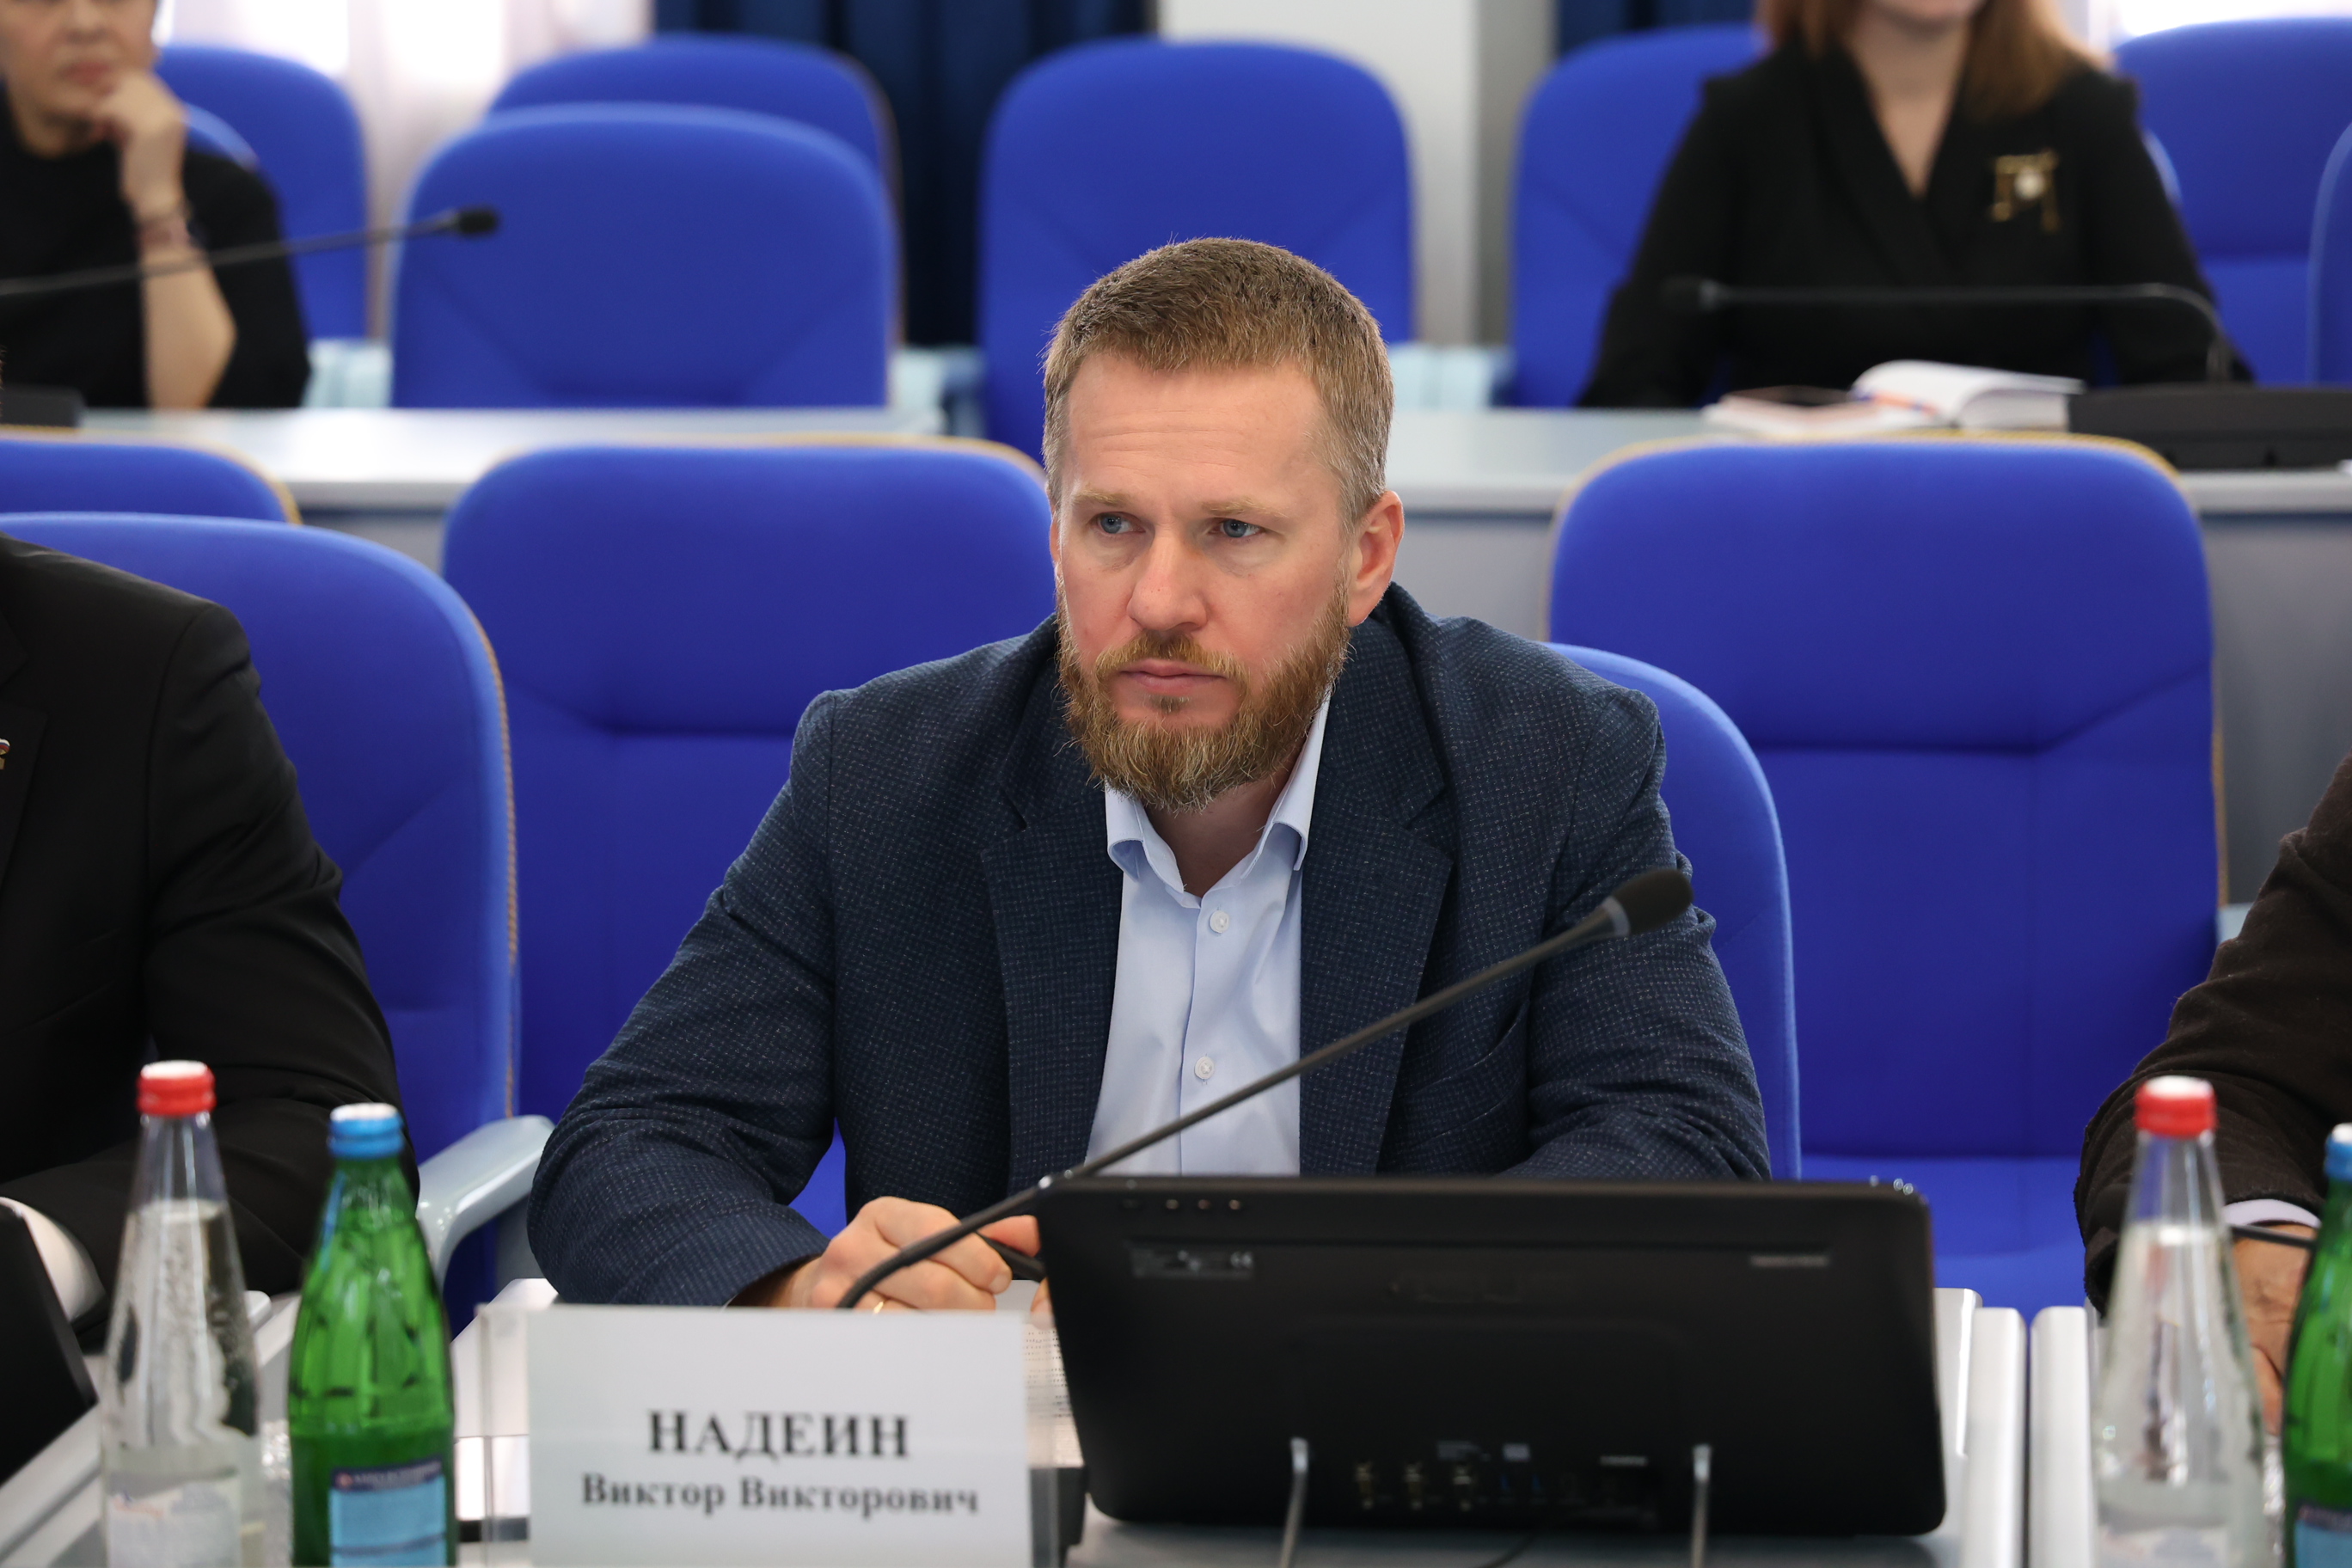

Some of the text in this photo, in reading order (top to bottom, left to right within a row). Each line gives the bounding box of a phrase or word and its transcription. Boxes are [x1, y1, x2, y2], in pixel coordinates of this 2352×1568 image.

[649, 1411, 908, 1461] НАДЕИН
[582, 1473, 977, 1520] Виктор Викторович
